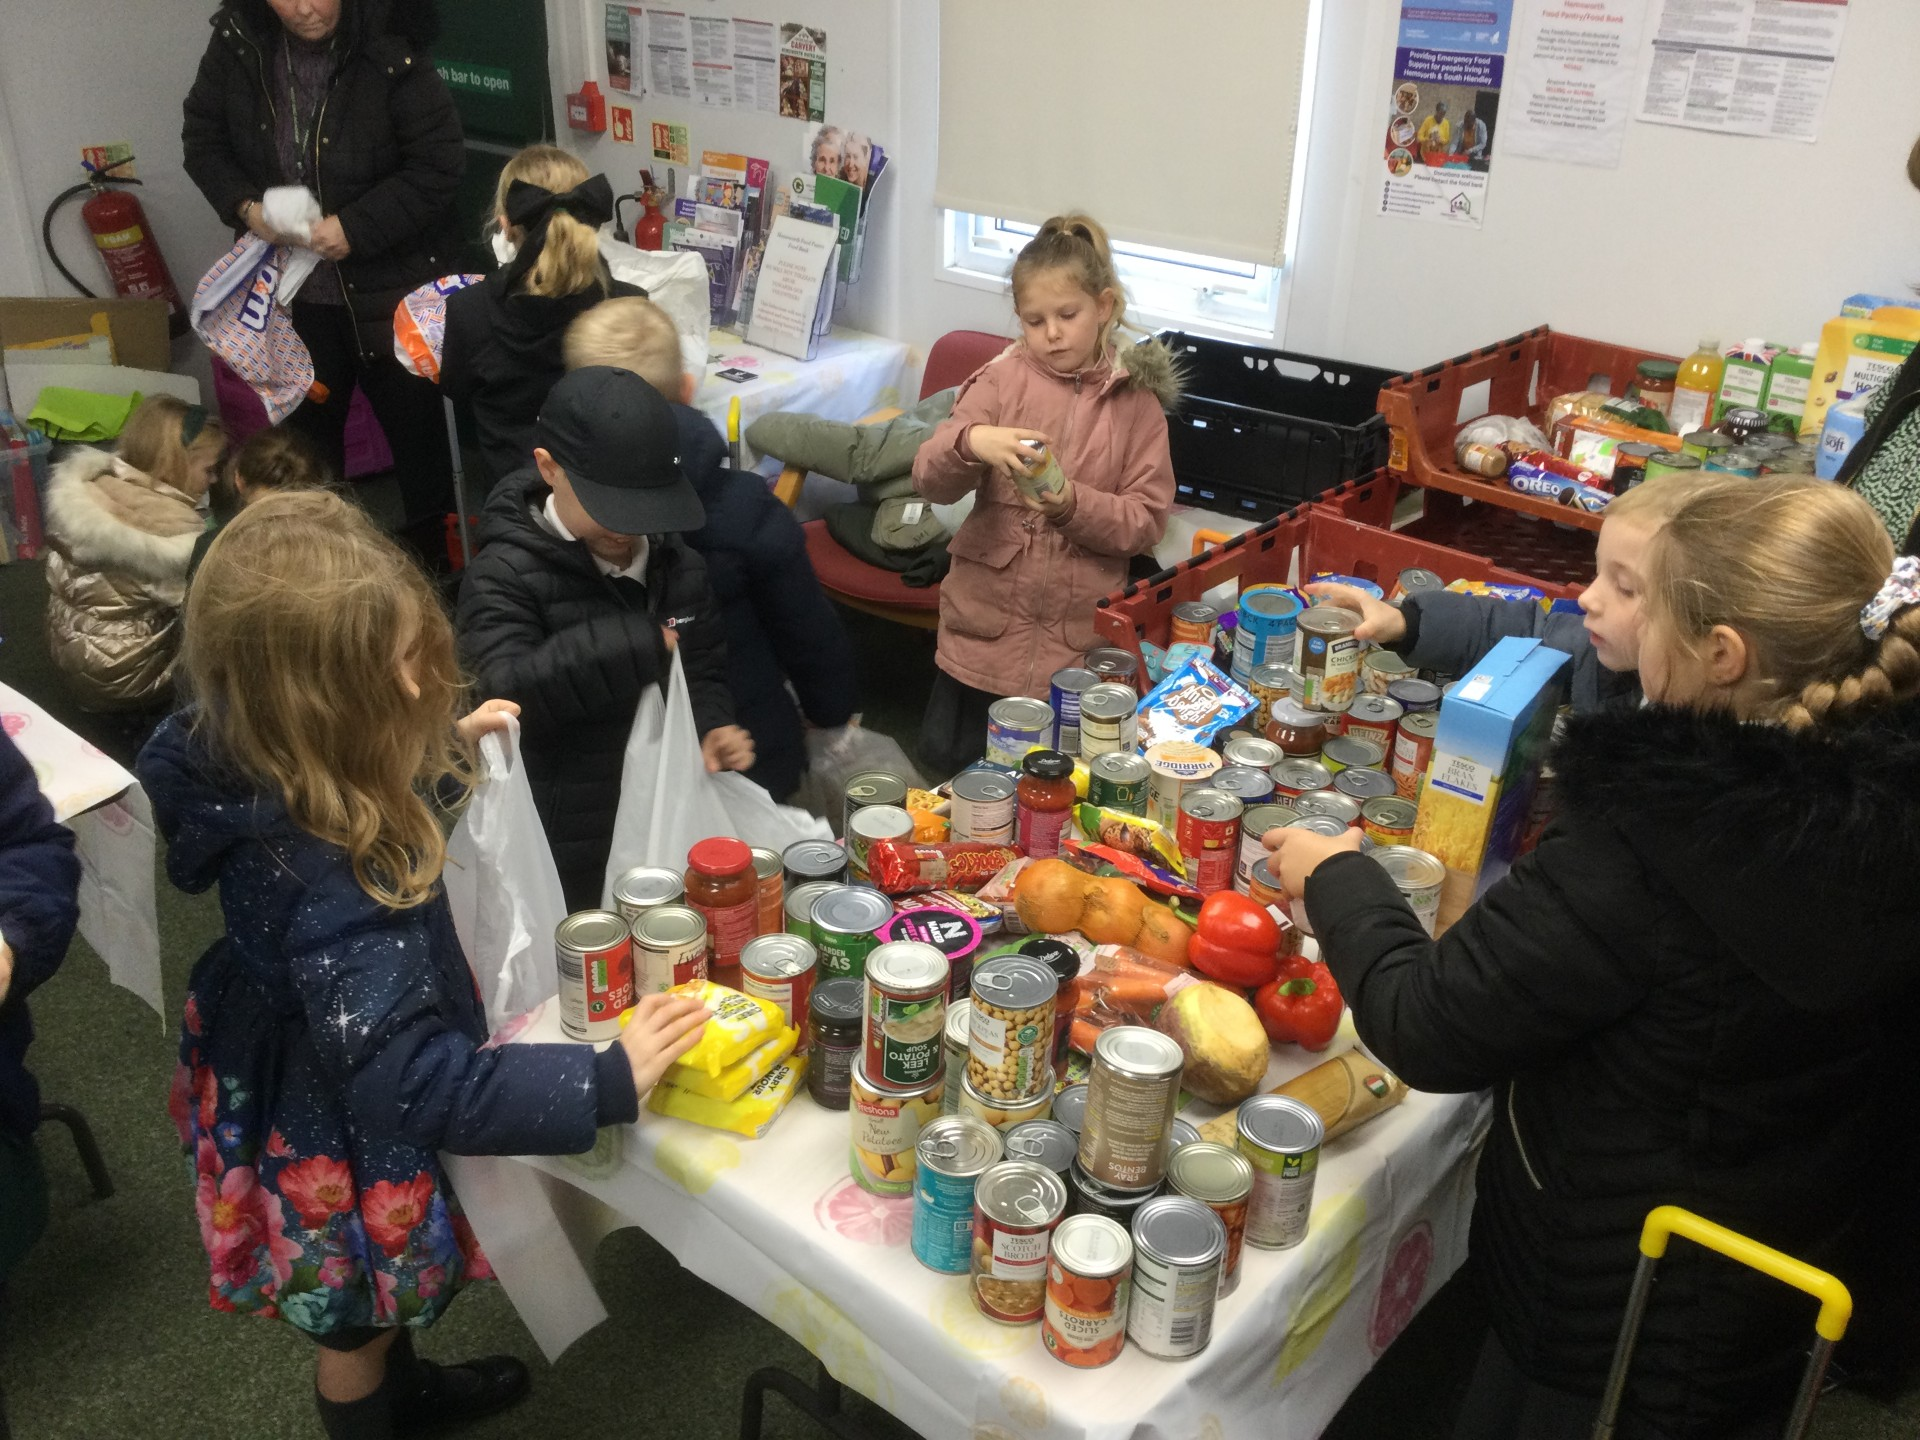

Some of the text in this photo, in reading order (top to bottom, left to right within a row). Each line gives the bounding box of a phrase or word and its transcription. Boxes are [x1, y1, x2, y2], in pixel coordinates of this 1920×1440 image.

[1543, 10, 1559, 18] Food
[1606, 15, 1624, 23] Bank
[1409, 50, 1491, 65] Providing Emergency Food
[1408, 60, 1430, 70] Support
[1431, 63, 1440, 71] for
[1441, 64, 1464, 75] people
[1464, 64, 1482, 75] living
[451, 68, 467, 83] bar
[470, 71, 480, 85] to
[483, 76, 509, 91] open
[1437, 72, 1442, 80] &
[1443, 72, 1462, 82] South
[1449, 177, 1458, 185] the
[1458, 179, 1470, 187] food
[1512, 477, 1560, 495] OREO
[1180, 684, 1219, 717] Angel
[1350, 727, 1385, 740] HEINZ
[1155, 760, 1214, 770] PORRIDGE
[1447, 766, 1475, 782] BRAN
[1441, 773, 1478, 791] FLAKES
[927, 921, 944, 943] NAKED
[939, 921, 968, 940] N
[889, 1045, 938, 1061] & POTATO
[907, 1044, 927, 1052] SOUP
[903, 1058, 929, 1069] LEEK
[769, 1066, 790, 1092] CURRY
[858, 1103, 895, 1116] Freshona
[869, 1123, 889, 1135] New
[863, 1131, 902, 1146] Potatoes
[1108, 1162, 1147, 1173] BENTOS
[1114, 1173, 1139, 1182] FRAY
[1001, 1243, 1041, 1252] SCOTCH
[1004, 1251, 1038, 1259] BROTH
[1059, 1311, 1107, 1326] CARROTS
[1064, 1322, 1100, 1334] SLICED
